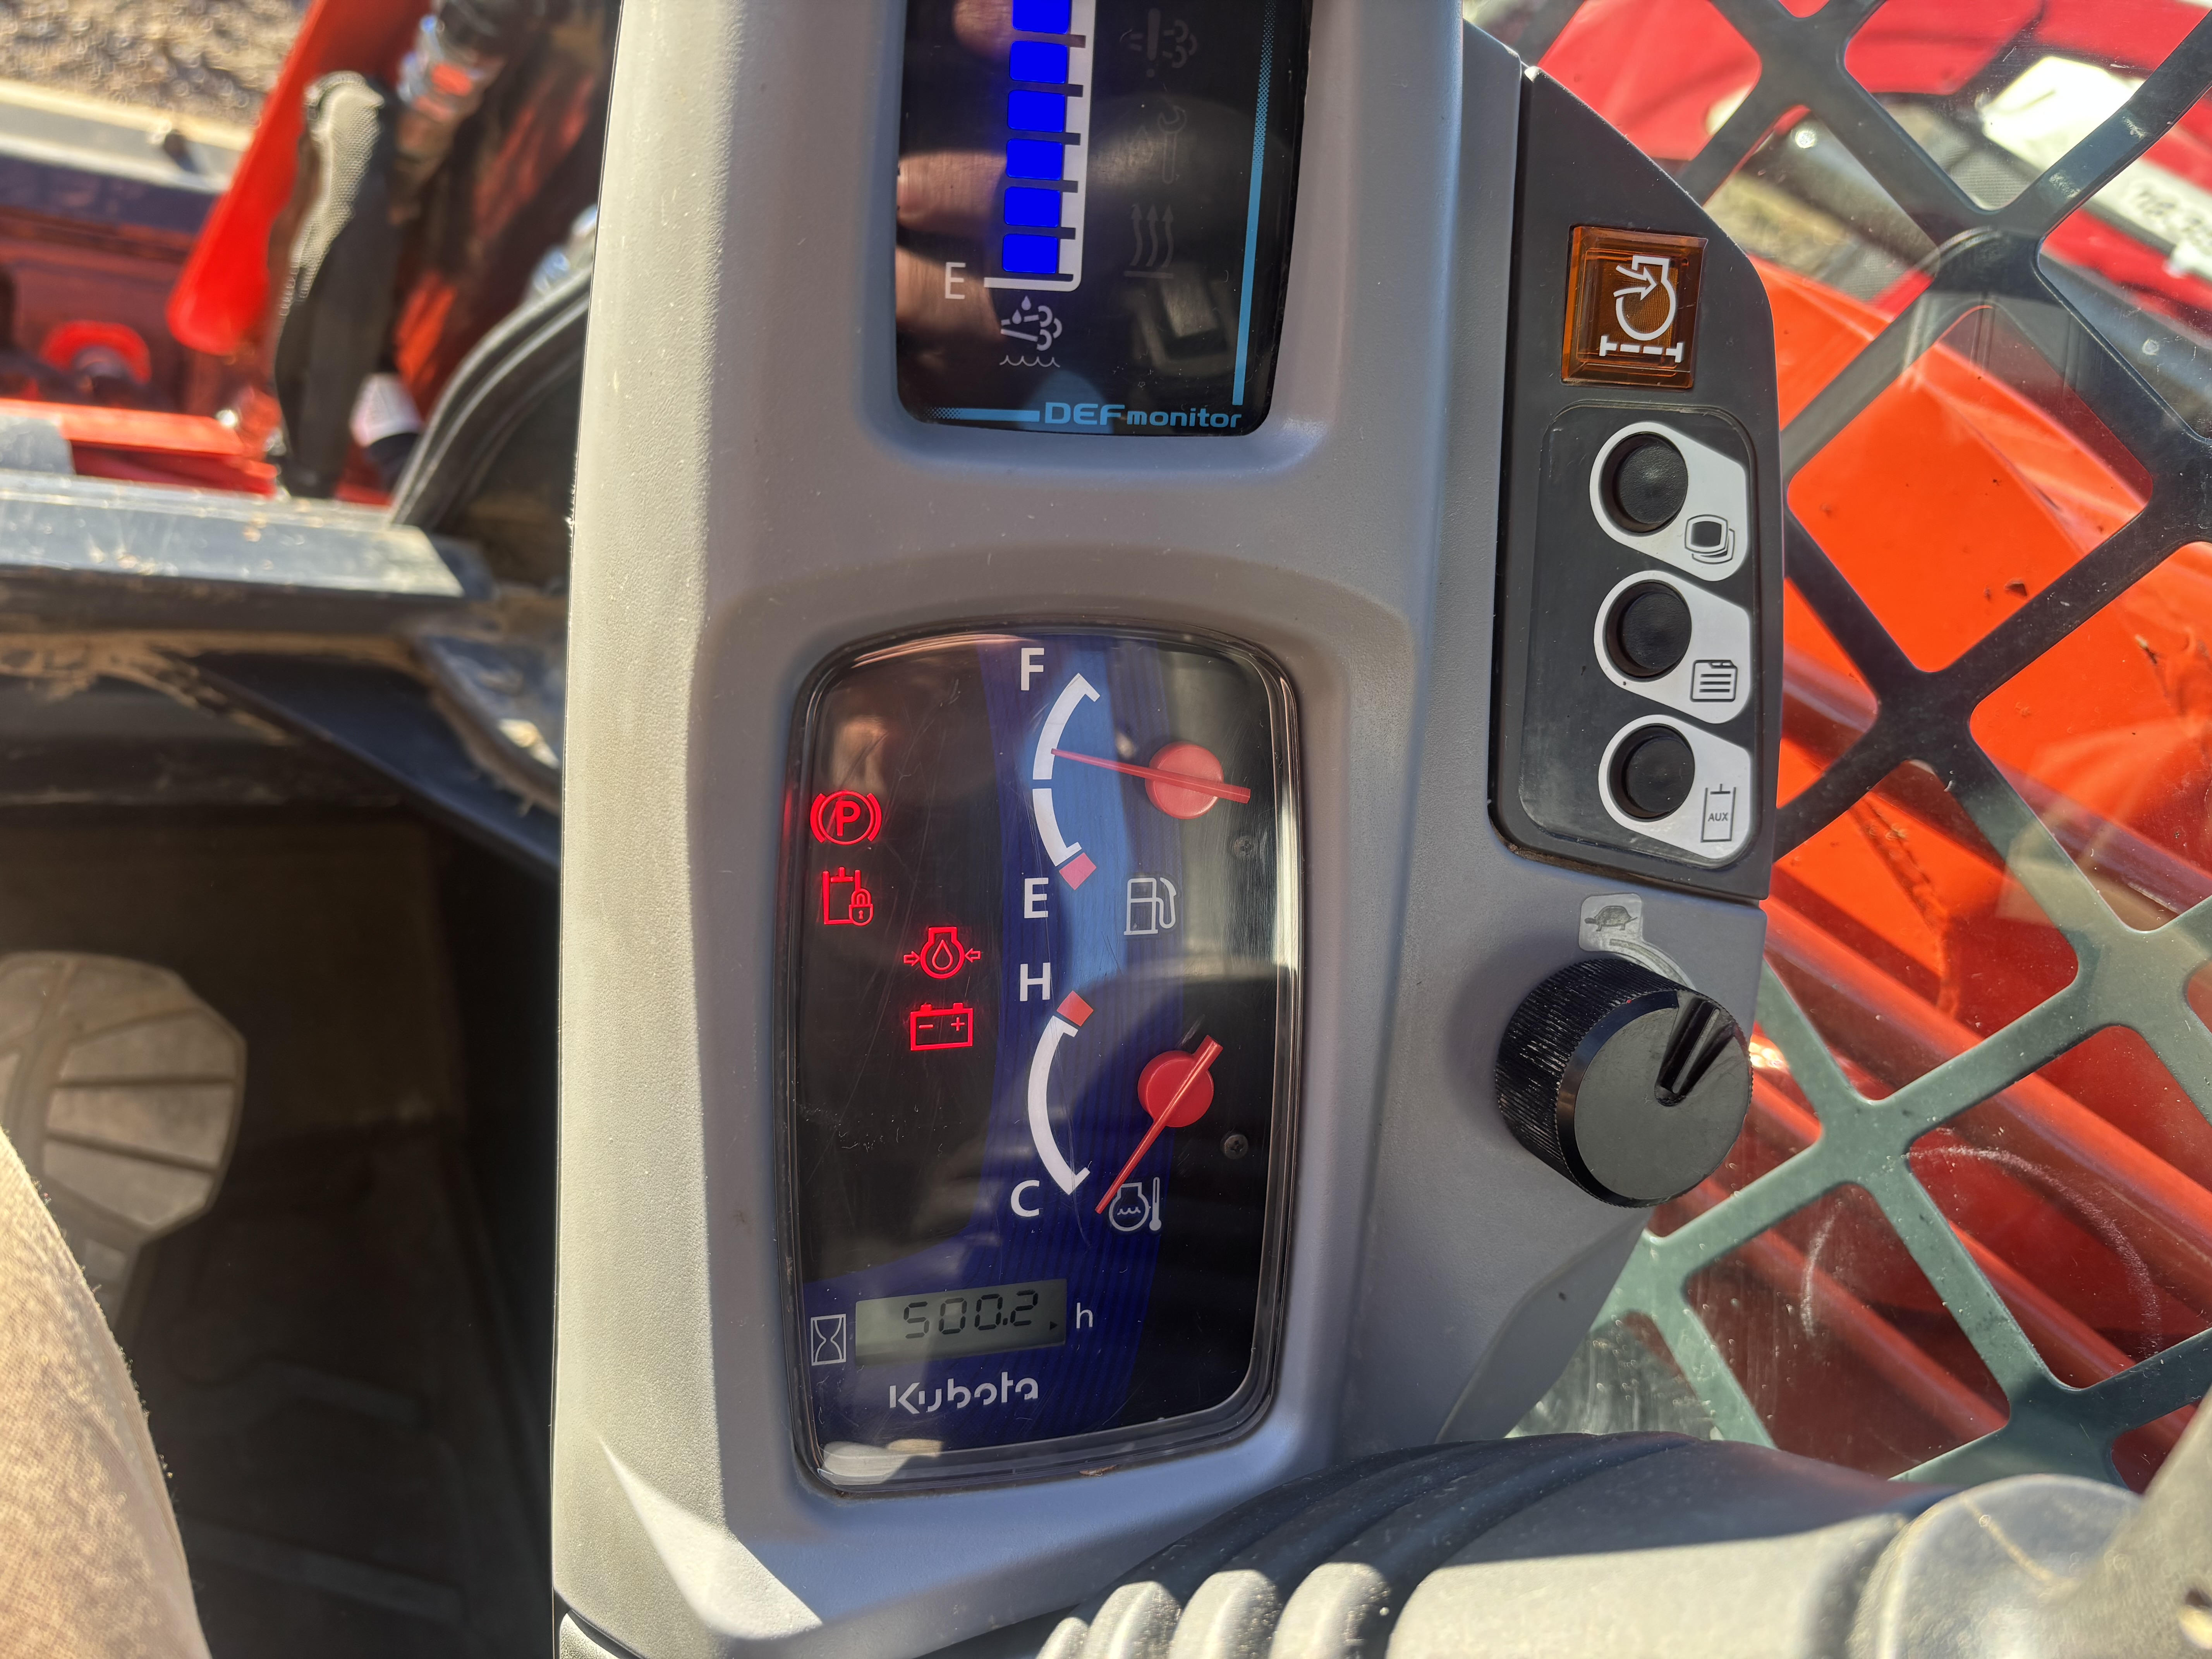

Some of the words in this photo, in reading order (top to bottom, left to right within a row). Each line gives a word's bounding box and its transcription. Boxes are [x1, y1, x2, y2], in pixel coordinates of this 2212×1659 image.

[945, 262, 966, 300] E
[1021, 647, 1044, 690] F
[836, 800, 861, 836] P
[1708, 812, 1728, 821] AUX
[1024, 878, 1049, 918] E
[1020, 962, 1051, 1002] H
[1010, 1180, 1040, 1217] C
[904, 1290, 1038, 1339] 500.2
[1077, 1303, 1093, 1329] h
[890, 1372, 1038, 1415] Kubota
